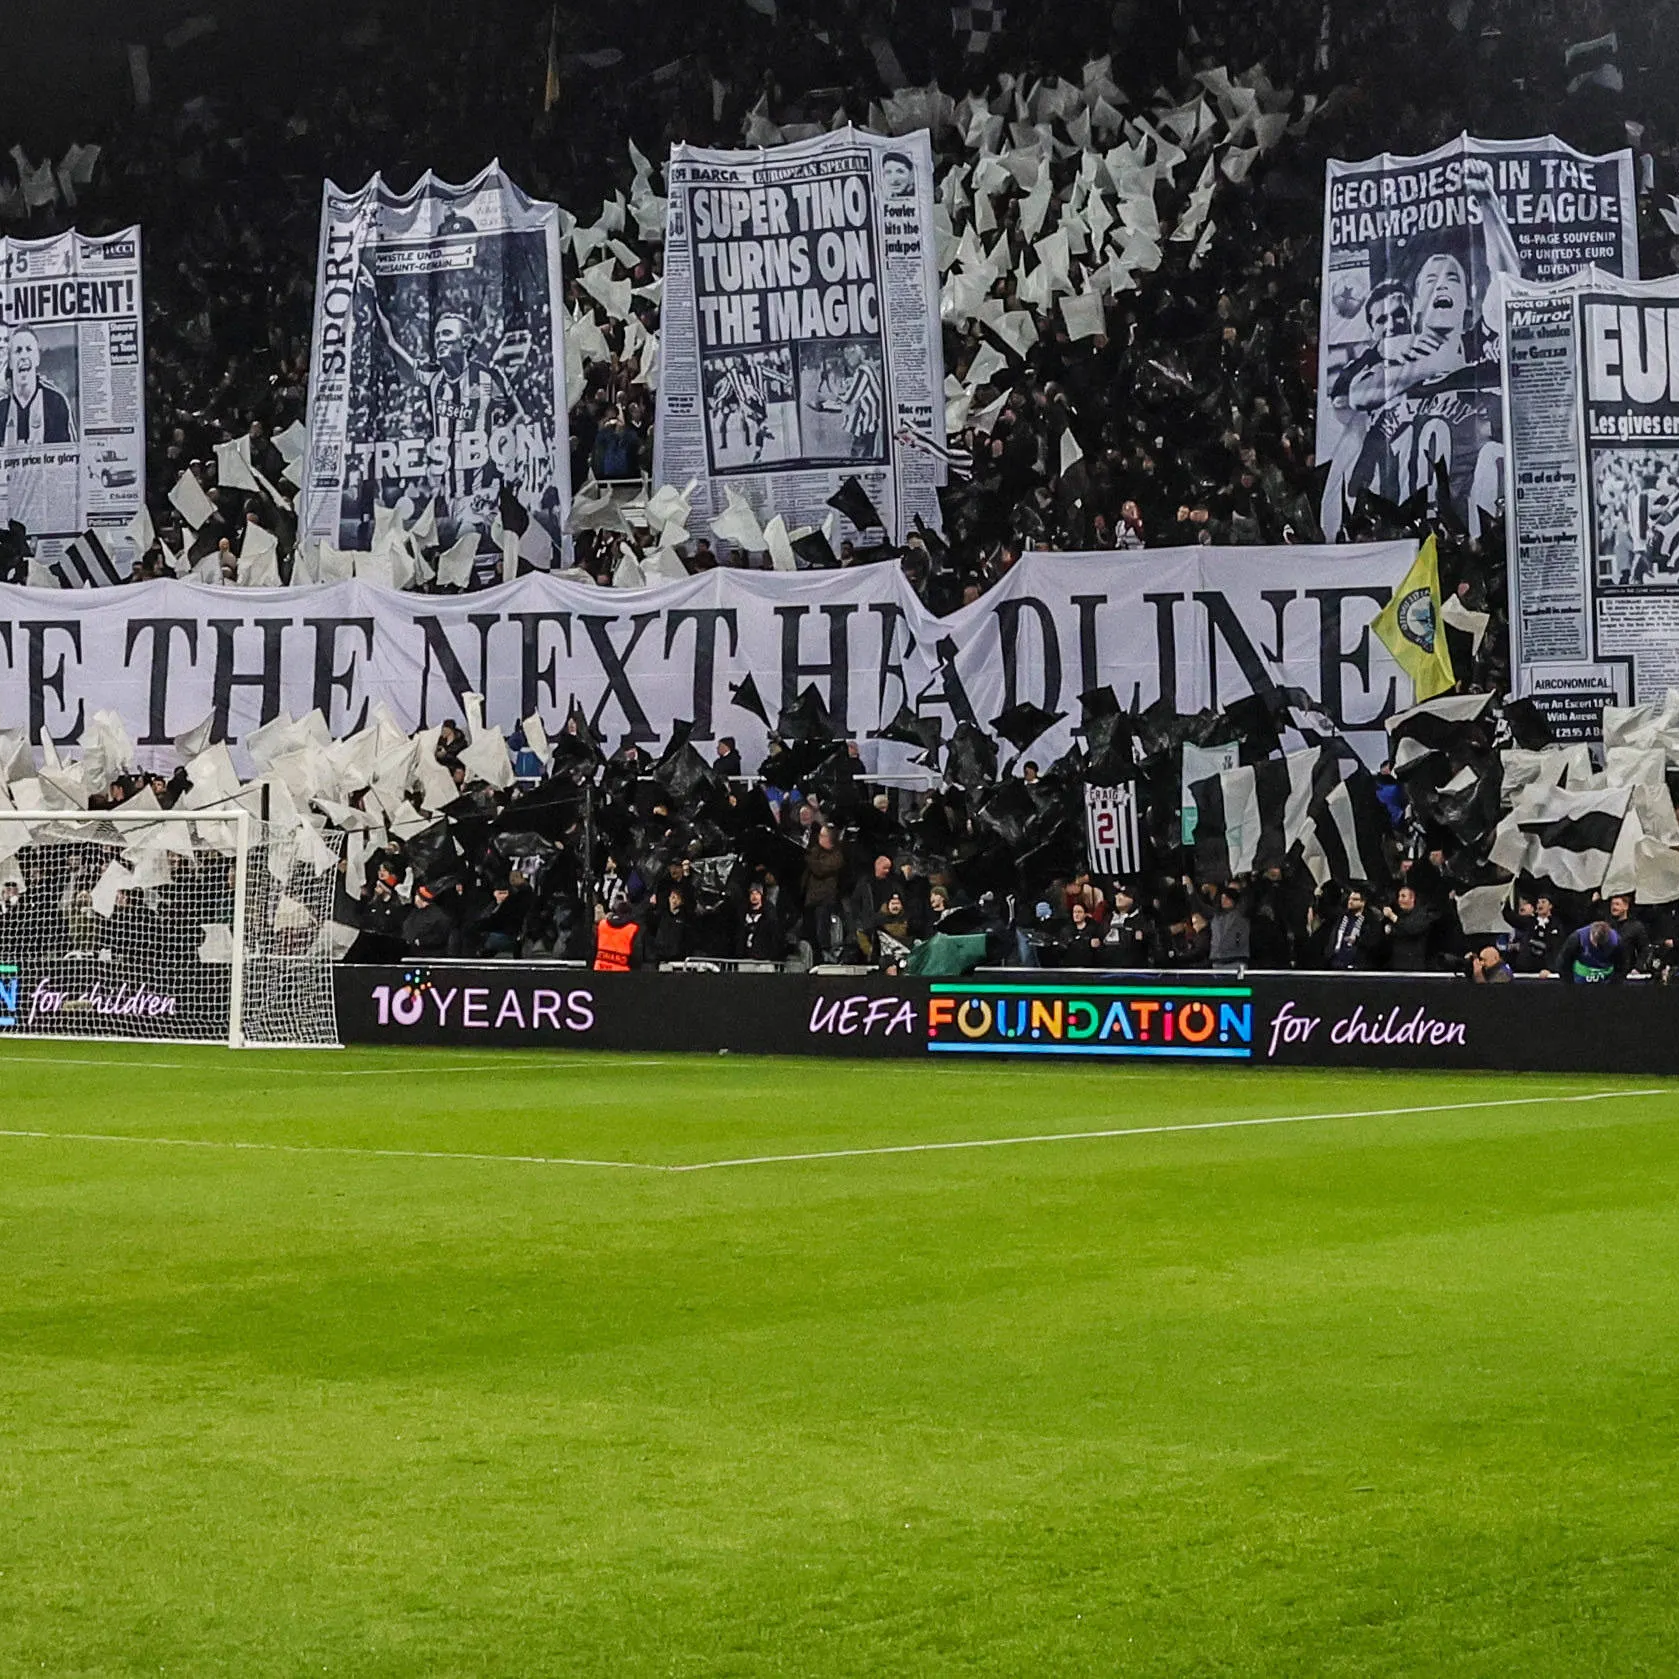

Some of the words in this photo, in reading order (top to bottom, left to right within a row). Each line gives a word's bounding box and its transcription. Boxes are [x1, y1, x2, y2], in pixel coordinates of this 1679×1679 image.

[691, 169, 740, 181] BARCA
[1332, 160, 1463, 212] GEORDIES
[1499, 160, 1530, 191] IN
[1540, 160, 1596, 190] THE
[693, 186, 790, 239] SUPER
[792, 176, 867, 232] TINO
[883, 203, 915, 218] Fowler
[1330, 195, 1483, 246] CHAMPIONS
[1502, 194, 1618, 224] LEAGUE
[884, 222, 902, 235] hits
[903, 222, 919, 234] the
[1563, 232, 1616, 243] SOUVENIR
[697, 235, 811, 292] TURNS
[817, 230, 872, 282] ON
[884, 240, 921, 256] jackpot
[1585, 247, 1614, 258] EURO
[322, 225, 354, 374] SPORT
[698, 293, 761, 345] THE
[767, 282, 879, 341] MAGIC
[1511, 309, 1571, 326] Mirror
[1589, 408, 1616, 435] Les
[1617, 409, 1661, 441] gives
[22, 455, 41, 467] price
[43, 453, 54, 464] for
[58, 452, 80, 465] glory
[347, 436, 451, 480] TRES
[1390, 418, 1452, 507] 10
[124, 616, 375, 747] THE
[409, 607, 738, 744] NEXT
[768, 586, 1398, 741] HEADLINE
[1534, 678, 1609, 690] AIRCONOMICAL
[1547, 711, 1568, 722] With
[1089, 789, 1119, 801] CRAIG
[1097, 812, 1115, 845] 2
[28, 977, 63, 1026] for
[809, 995, 918, 1036] UEFA
[1267, 1000, 1320, 1057] for
[1330, 1003, 1466, 1046] children
